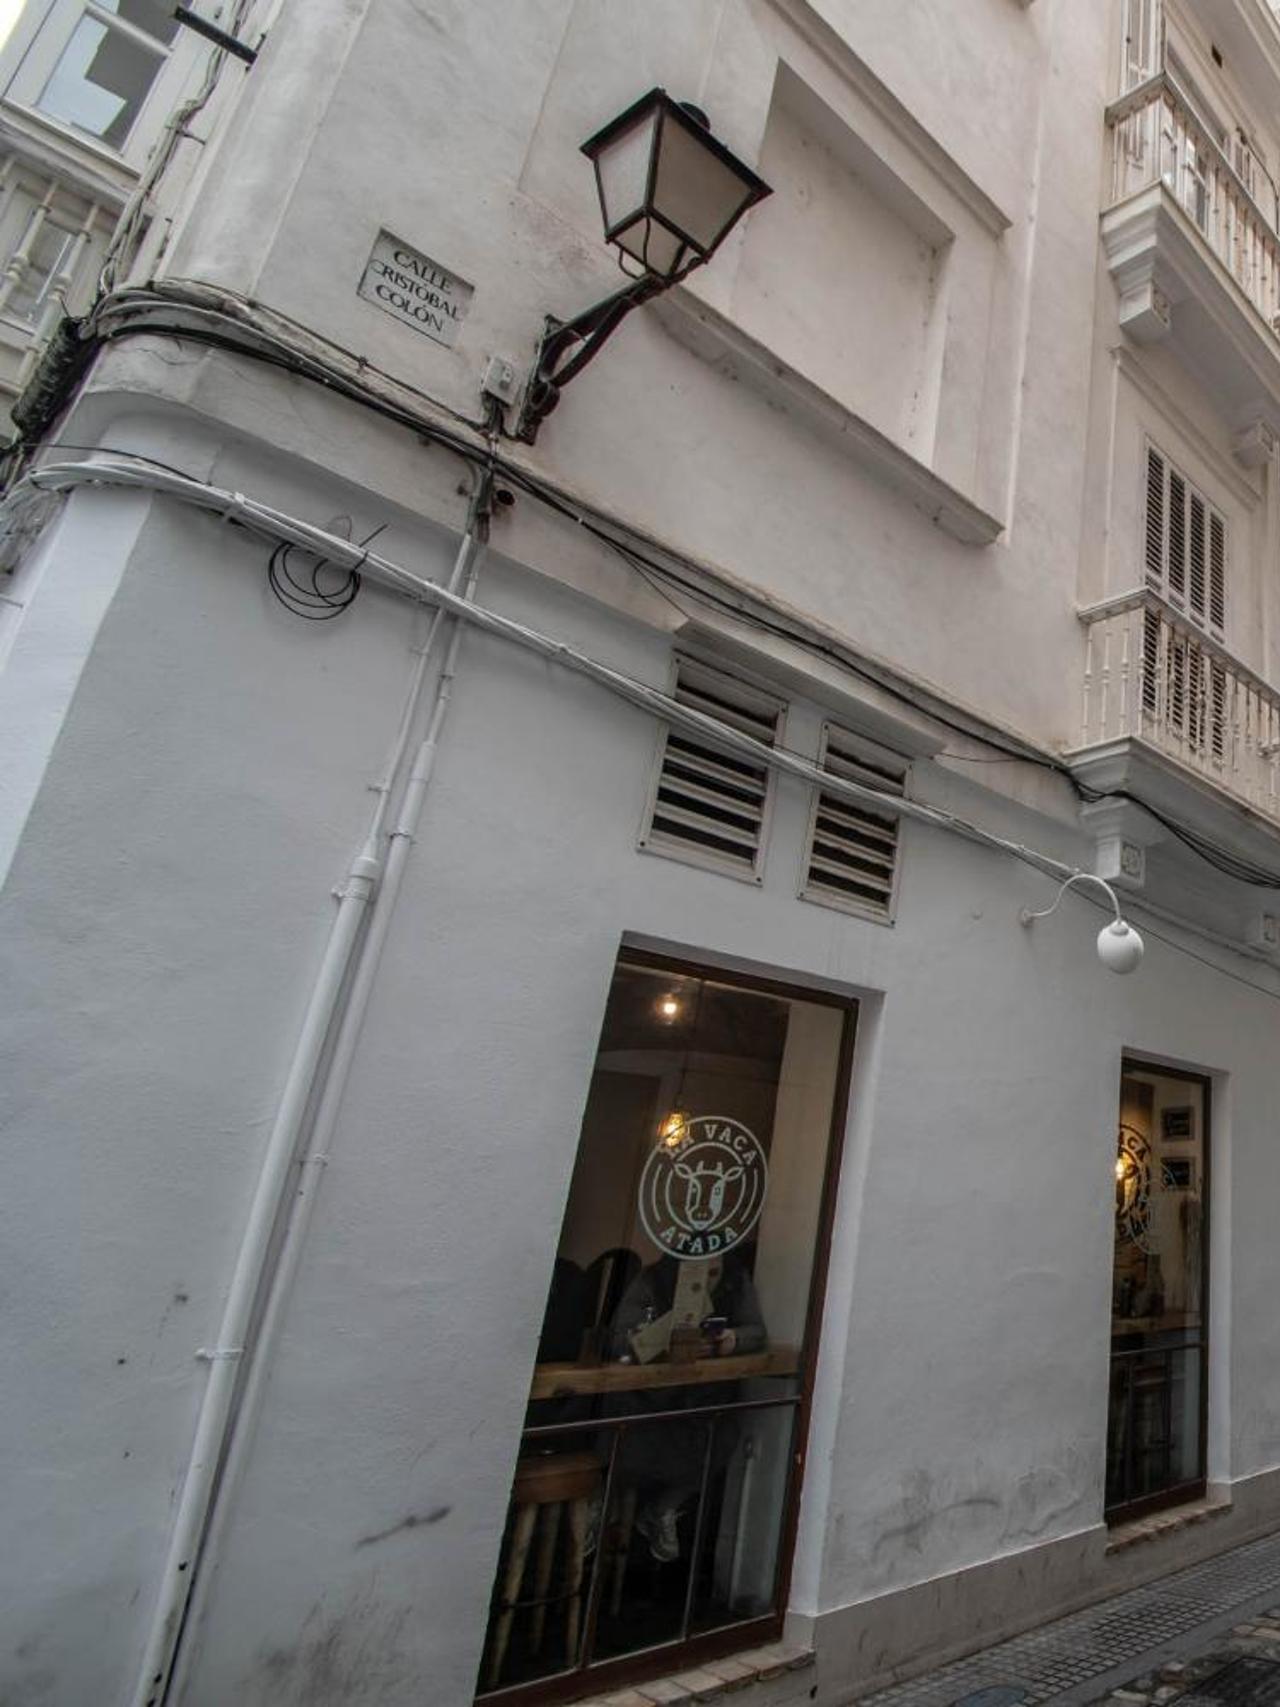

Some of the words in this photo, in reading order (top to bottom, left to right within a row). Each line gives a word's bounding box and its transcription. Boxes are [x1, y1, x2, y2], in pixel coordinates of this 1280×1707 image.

[370, 259, 463, 322] CRISTÓBAL
[393, 250, 452, 295] CALLE
[375, 284, 443, 332] COLÓN
[705, 1124, 757, 1165] VACA
[660, 1226, 737, 1253] ATADA
